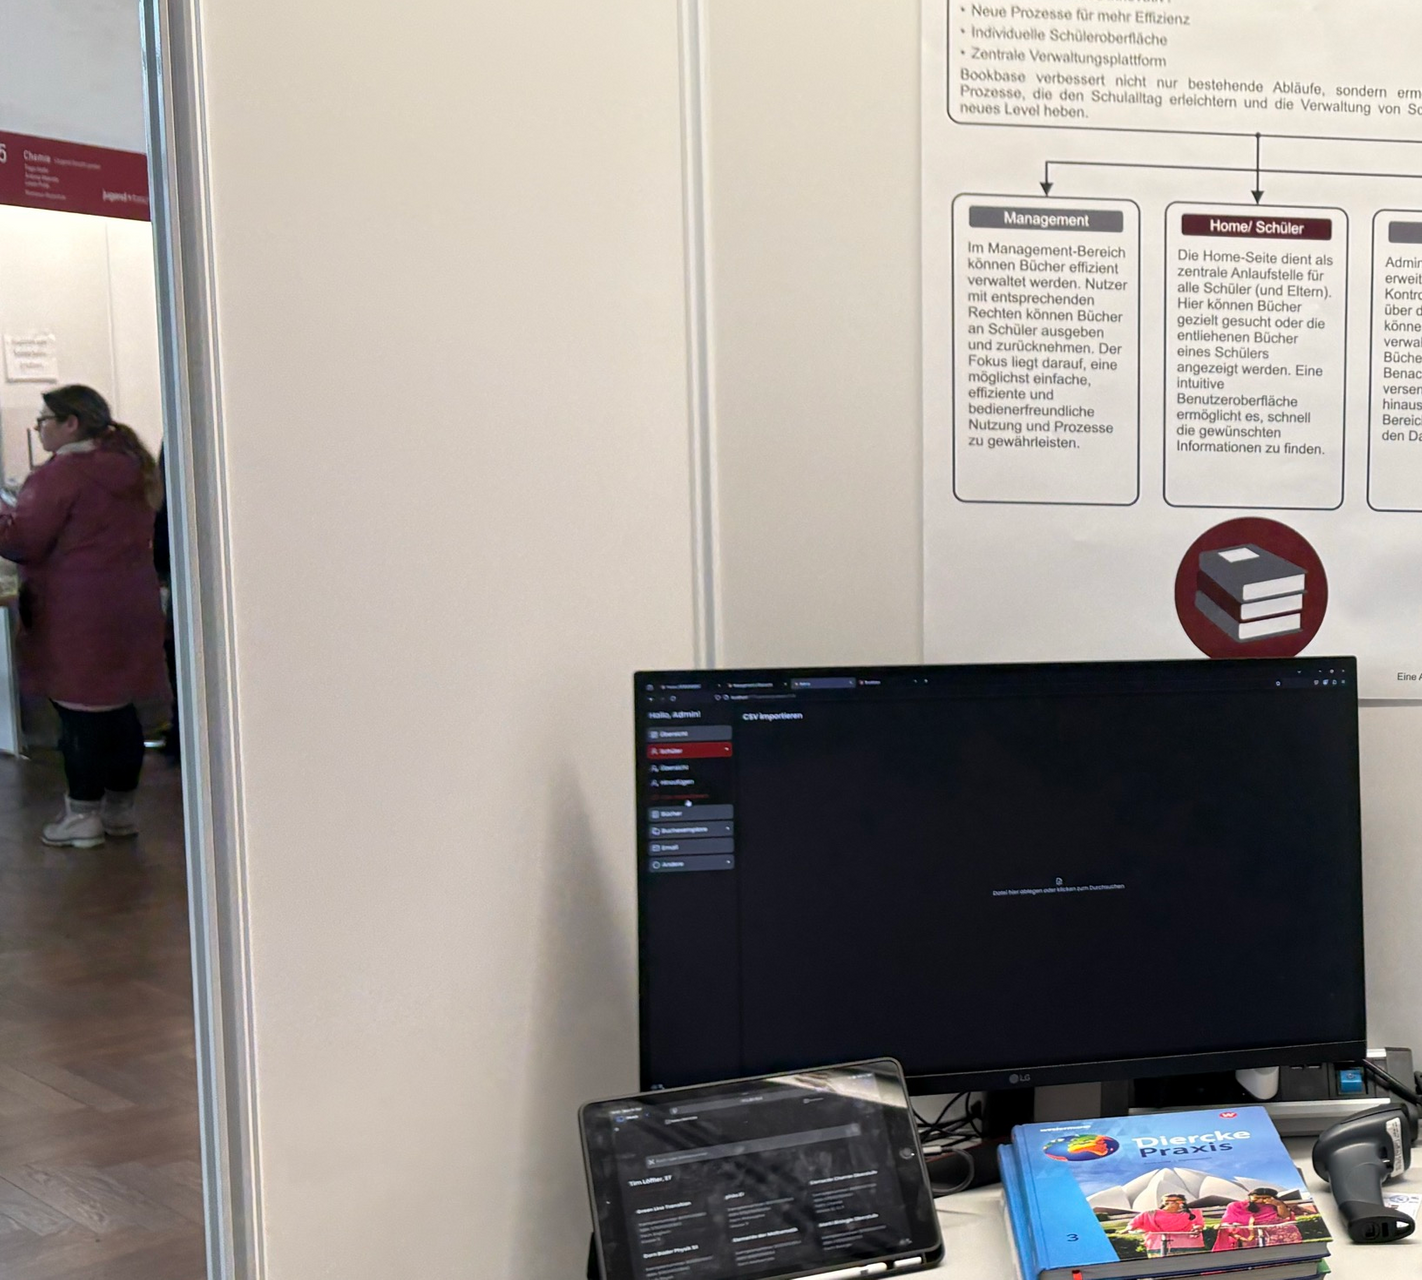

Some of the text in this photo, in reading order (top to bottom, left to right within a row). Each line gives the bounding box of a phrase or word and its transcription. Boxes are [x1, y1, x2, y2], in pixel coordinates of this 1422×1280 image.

[971, 5, 1190, 25] Neue Prozesse für mehr Effizienz
[971, 27, 1168, 45] Individuelle Schüleroberfläche
[970, 47, 1166, 67] Zentrale Verwaltungsplattform
[960, 68, 1026, 82] Bookbase
[1035, 73, 1105, 86] verbessert
[1115, 75, 1146, 87] nicht
[1156, 78, 1178, 88] nur
[1188, 78, 1263, 92] bestehende
[1272, 81, 1325, 96] Abläufe,
[1335, 85, 1387, 98] sondern
[959, 85, 1025, 100] Prozesse,
[1032, 88, 1052, 100] die
[1058, 89, 1084, 101] den
[1090, 90, 1162, 107] Schulalltag
[1168, 94, 1237, 107] erleichtern
[1243, 97, 1268, 109] und
[1274, 97, 1294, 110] die
[1300, 98, 1371, 116] Verwaltung
[1377, 104, 1400, 114] von
[24, 150, 51, 163] Chemie
[1003, 212, 1089, 227] Management
[1209, 219, 1304, 234] Home/ Schüler
[967, 242, 1126, 258] Im Management-Bereich
[1177, 248, 1333, 266] Die Home-Seite dient als
[967, 257, 1119, 274] können Bücher effizient
[967, 275, 1128, 290] verwaltet werden. Nutzer
[967, 290, 1095, 306] mit entsprechenden
[1176, 330, 1298, 344] entliehenen Bücher
[968, 370, 1091, 386] möglichst einfache,
[1176, 377, 1224, 389] intuitive
[967, 386, 1054, 400] effiziente und
[1176, 392, 1298, 407] Benutzeroberfläche
[968, 403, 1095, 417] bedienerfreundliche
[1176, 409, 1311, 425] ermöglicht es, schnell
[968, 418, 1113, 434] Nutzung und Prozesse
[1176, 424, 1281, 439] die gewünschten
[968, 436, 1080, 449] zu gewährleisten.
[1381, 430, 1404, 441] den
[1176, 440, 1325, 454] Informationen zu finden.
[1396, 672, 1417, 681] Eine
[742, 712, 804, 722] CSV importieren
[1019, 1074, 1031, 1082] LG
[1132, 1130, 1251, 1149] Diercke
[1139, 1141, 1233, 1158] Praxis
[1066, 1233, 1079, 1242] 3
